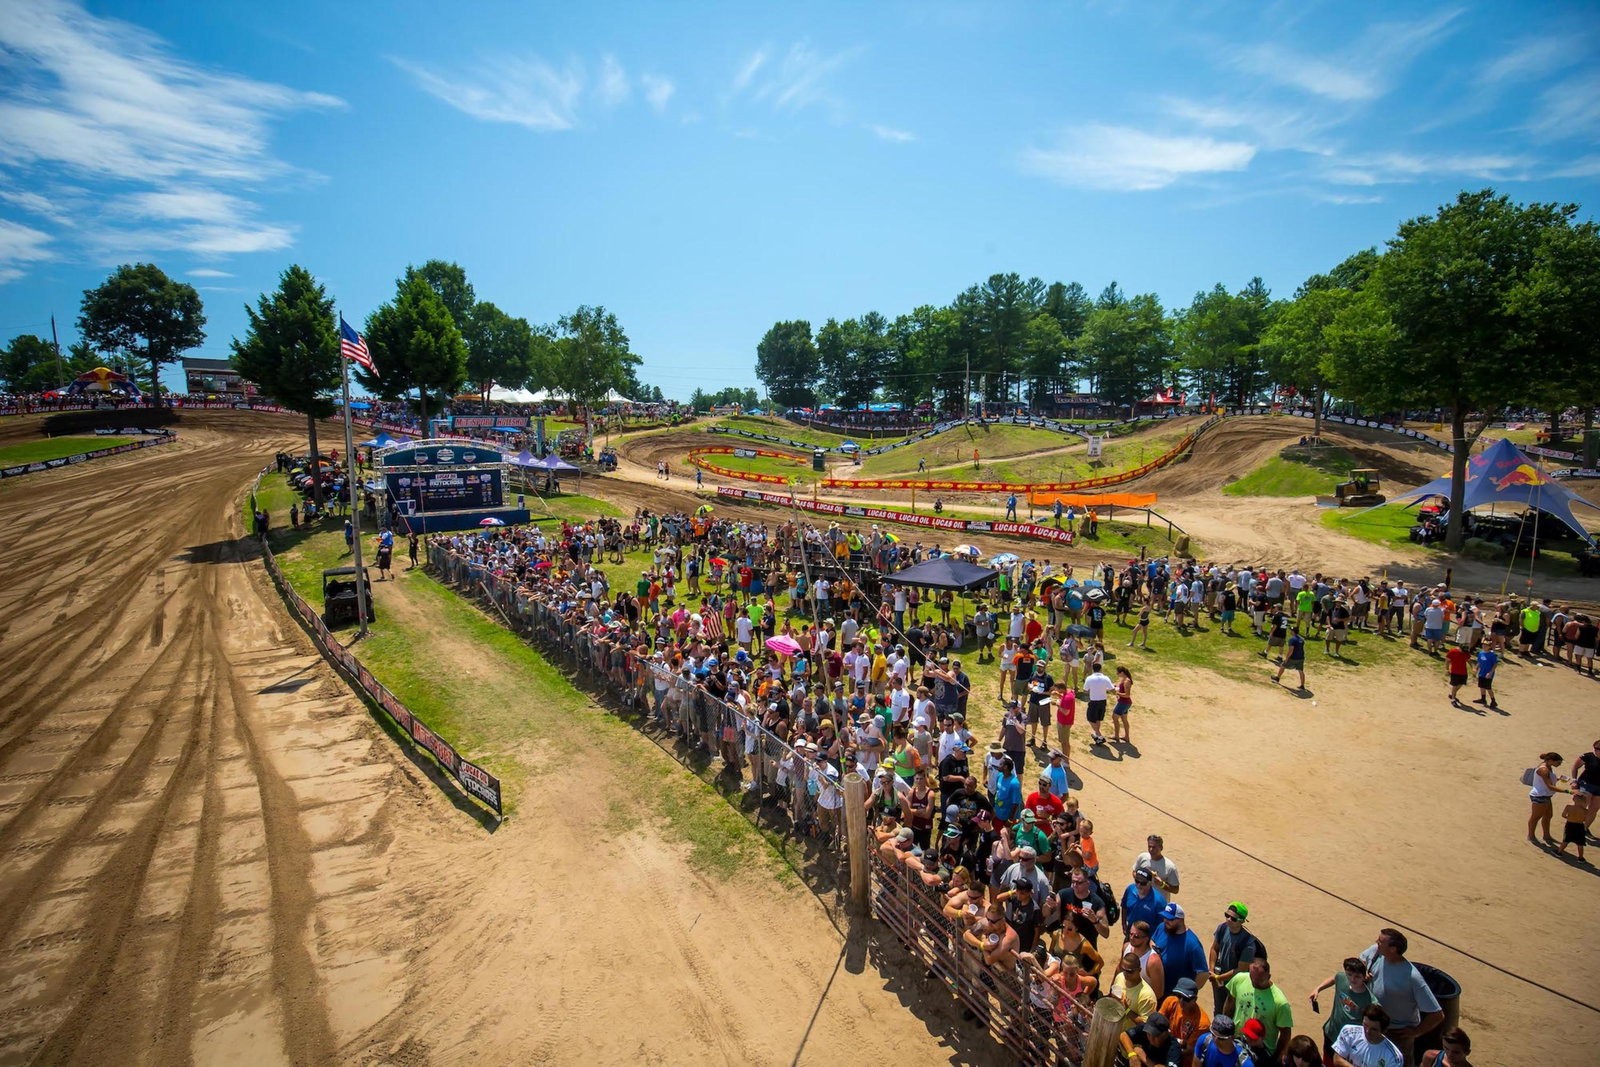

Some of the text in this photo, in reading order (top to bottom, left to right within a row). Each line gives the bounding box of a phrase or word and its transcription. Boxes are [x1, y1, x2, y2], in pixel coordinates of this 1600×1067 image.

[719, 487, 734, 496] LUCAS
[734, 489, 743, 497] OIL
[763, 494, 780, 503] LUCAS
[780, 496, 789, 504] OIL
[789, 498, 815, 509] LAS OIL
[816, 503, 834, 511] LUCAS
[834, 505, 843, 513] OIL
[867, 509, 887, 518] LUCAS
[887, 512, 897, 520] OIL
[899, 513, 930, 525] LUCAS OIL
[931, 518, 953, 528] LUCAS
[953, 521, 964, 529] OIL
[994, 523, 1018, 532] LUCAS
[1018, 525, 1031, 533] OIL
[1032, 527, 1073, 541] LUCAS OIL
[462, 761, 488, 786] LUCAS OIL
